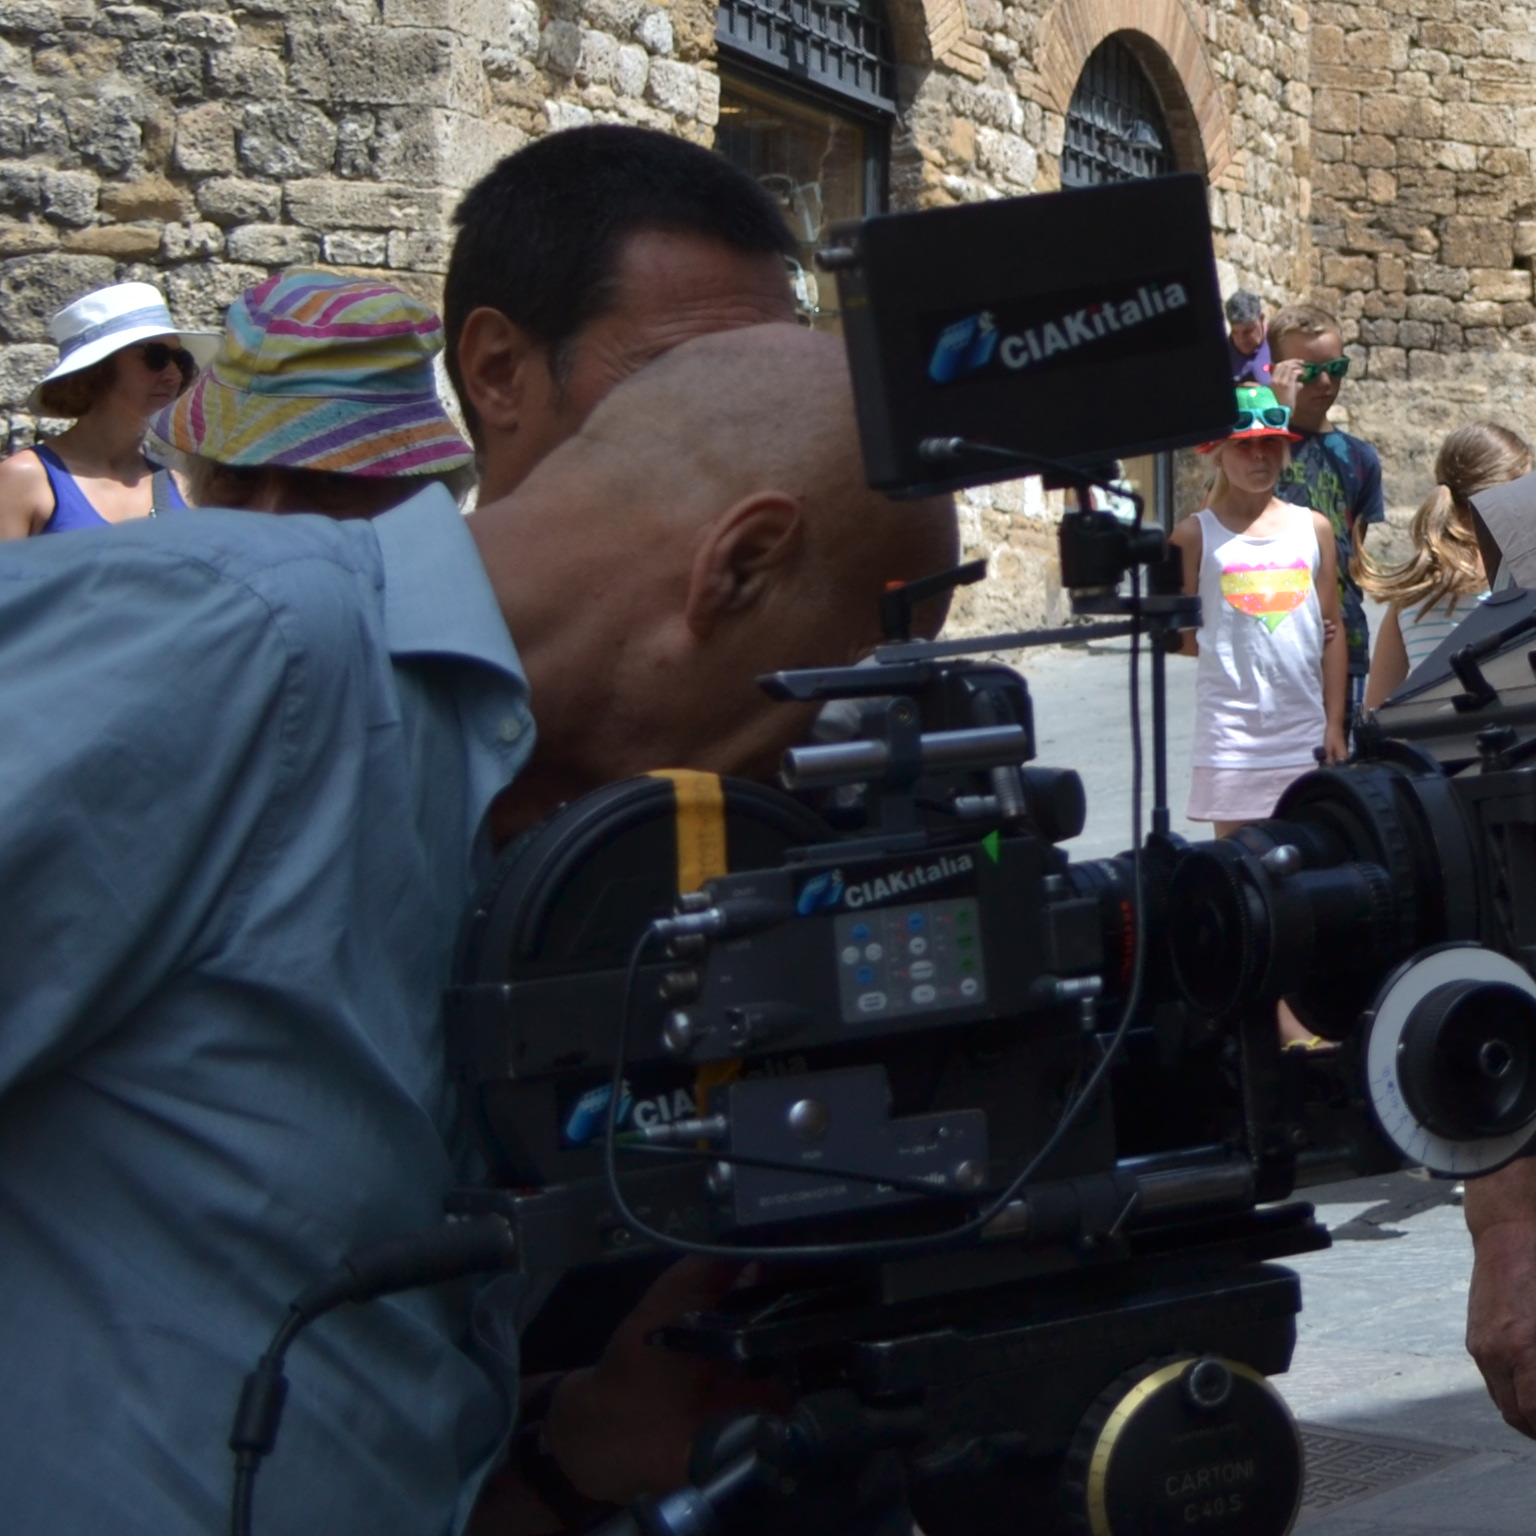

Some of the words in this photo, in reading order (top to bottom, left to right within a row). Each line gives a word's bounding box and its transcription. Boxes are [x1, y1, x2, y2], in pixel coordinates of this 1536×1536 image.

[1000, 281, 1188, 370] CIAKitalia
[844, 853, 975, 909] CIAKitalia
[1165, 1458, 1254, 1497] CARTONI
